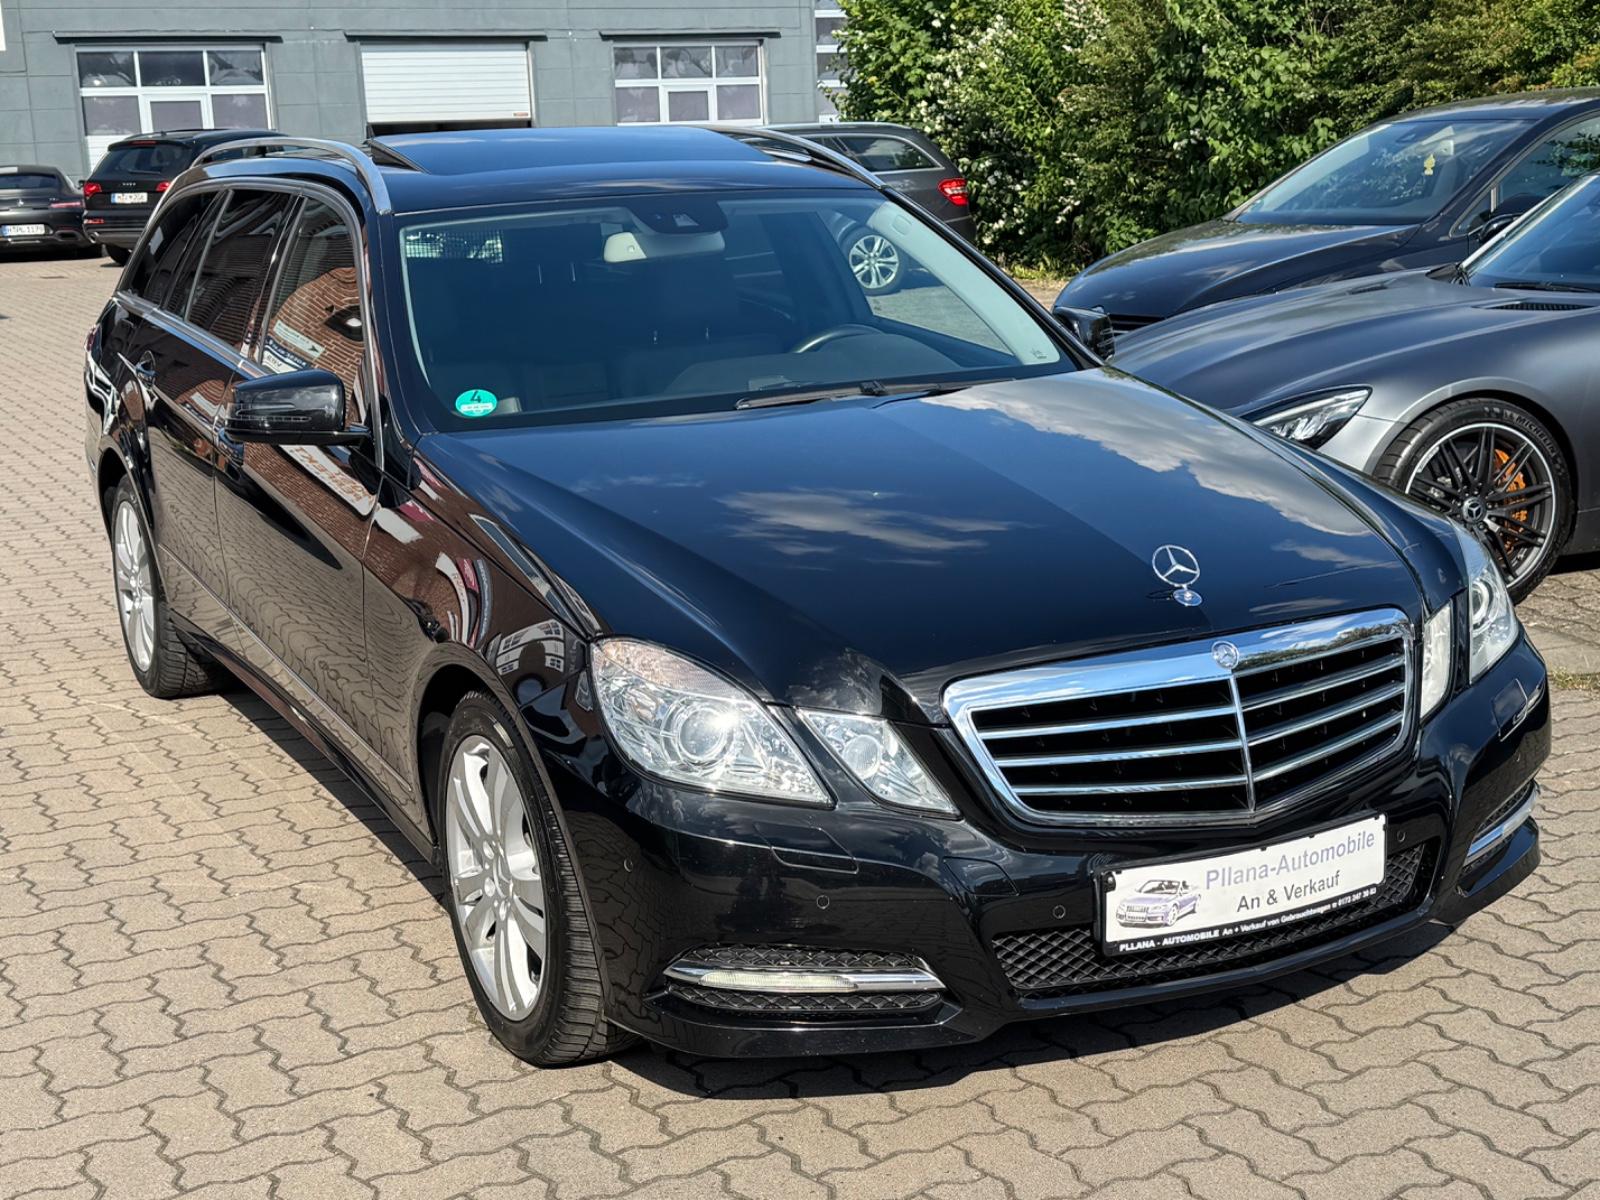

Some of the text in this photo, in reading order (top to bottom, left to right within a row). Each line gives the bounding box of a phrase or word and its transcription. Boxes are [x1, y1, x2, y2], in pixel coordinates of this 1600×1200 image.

[470, 390, 482, 404] 4
[1515, 415, 1556, 458] MICHELIN
[1206, 830, 1375, 890] Pllana-Automobile
[1236, 871, 1340, 912] An & Verkauf
[1119, 939, 1156, 952] PLLANA
[1161, 929, 1220, 946] AUTOMOBILE
[1222, 928, 1234, 936] An
[1239, 920, 1267, 932] Verkauf
[1267, 918, 1281, 926] von
